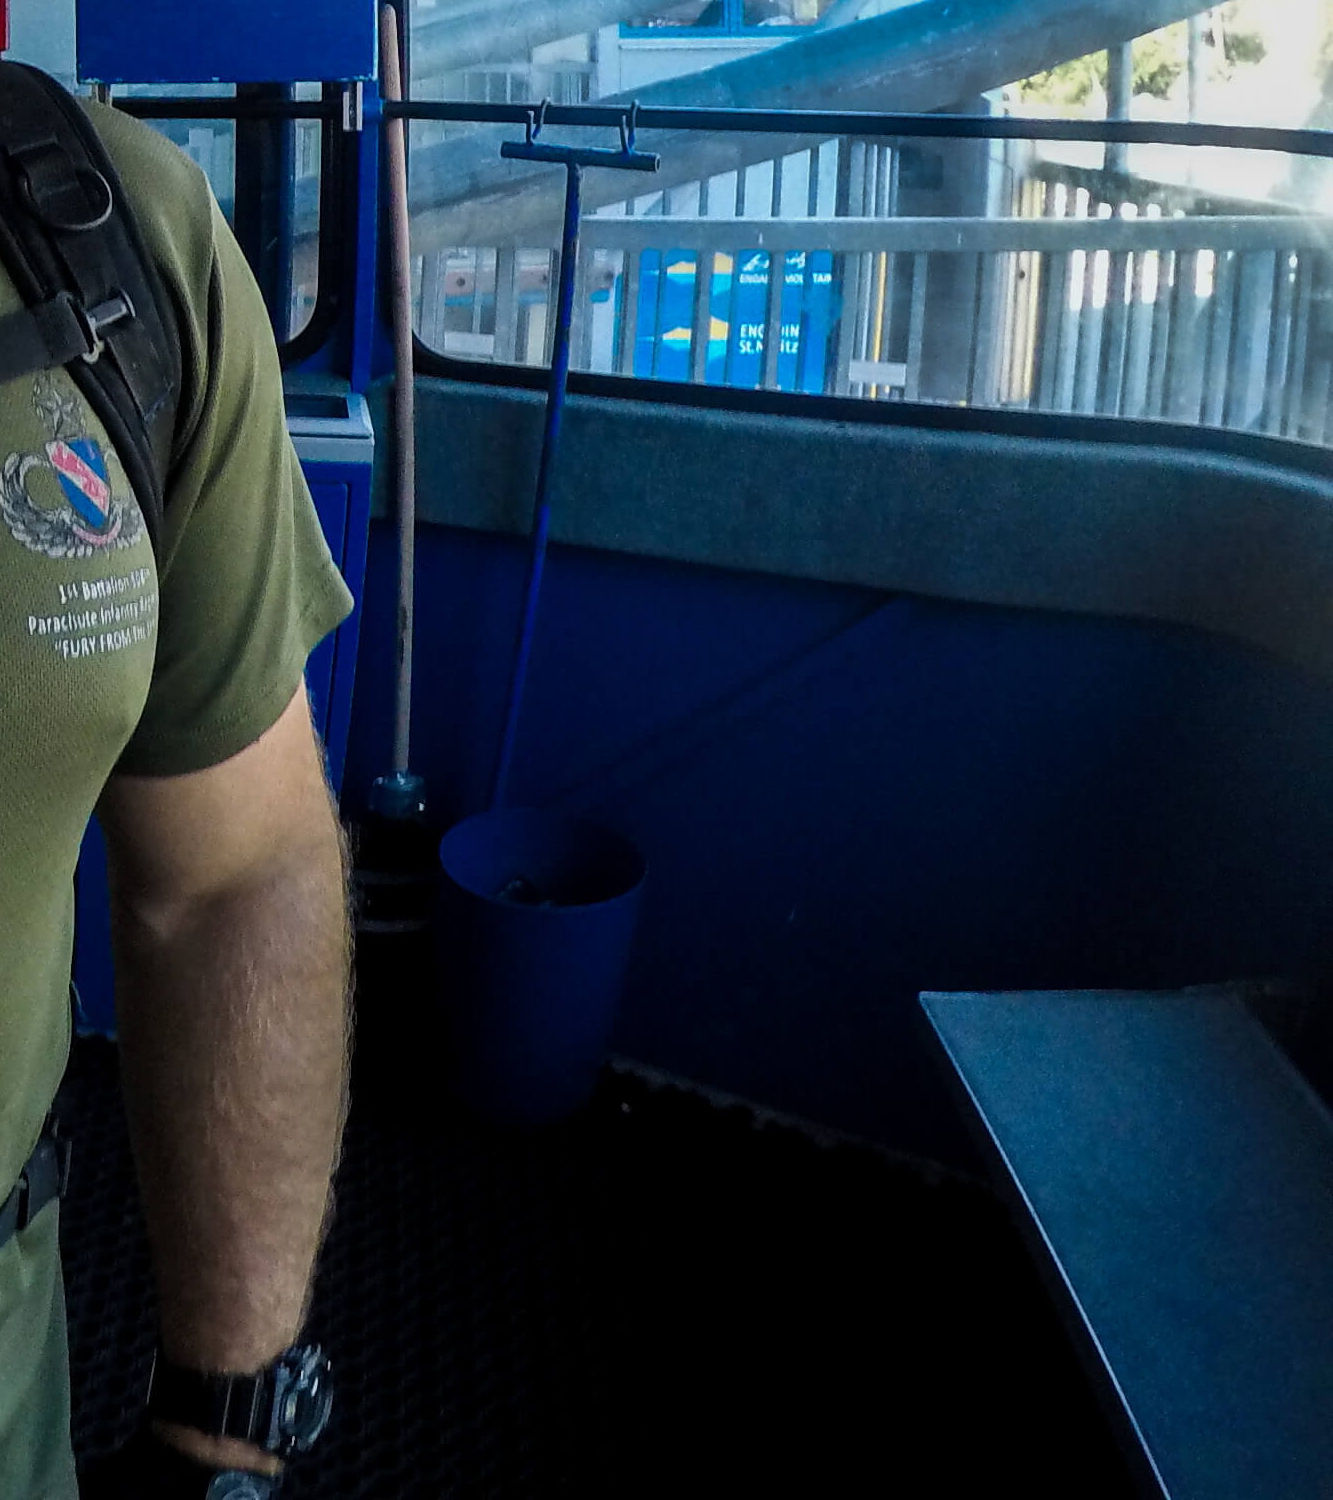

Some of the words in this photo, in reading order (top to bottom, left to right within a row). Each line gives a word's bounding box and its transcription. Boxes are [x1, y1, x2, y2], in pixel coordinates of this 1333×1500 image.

[81, 575, 130, 601] Battalion
[28, 610, 98, 636] Parachute
[99, 627, 132, 653] FROM
